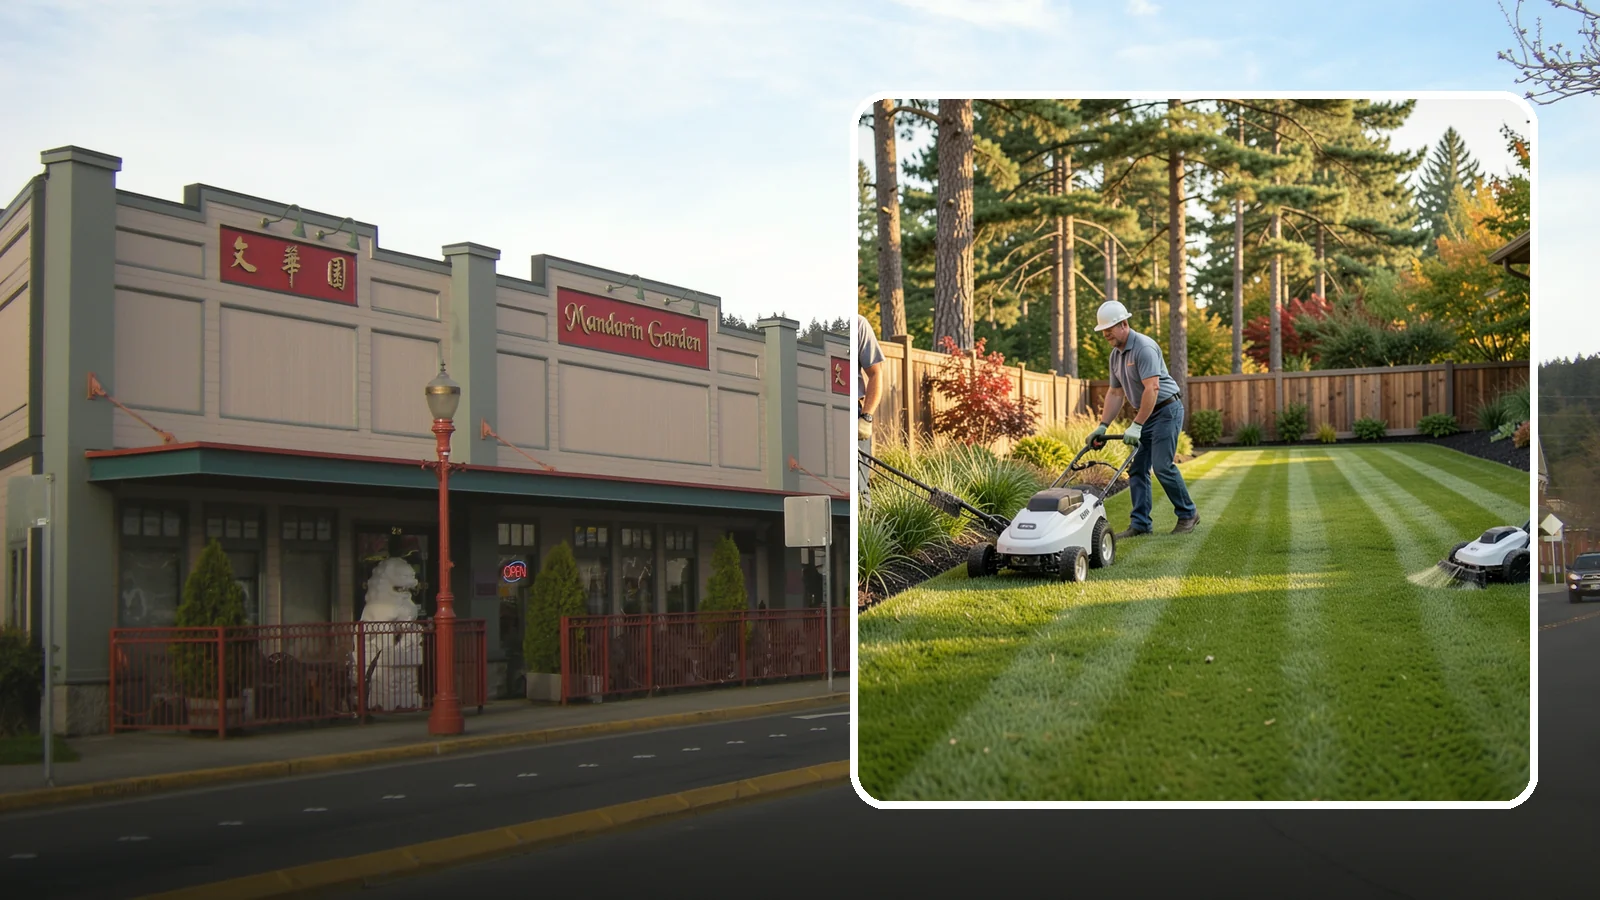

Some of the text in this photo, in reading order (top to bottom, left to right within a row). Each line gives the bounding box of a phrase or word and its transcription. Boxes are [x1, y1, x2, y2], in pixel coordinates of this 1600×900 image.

[230, 235, 346, 291] 文華園
[564, 302, 701, 352] Mandarin Garden
[834, 363, 847, 386] 文
[503, 565, 527, 578] OPEN
